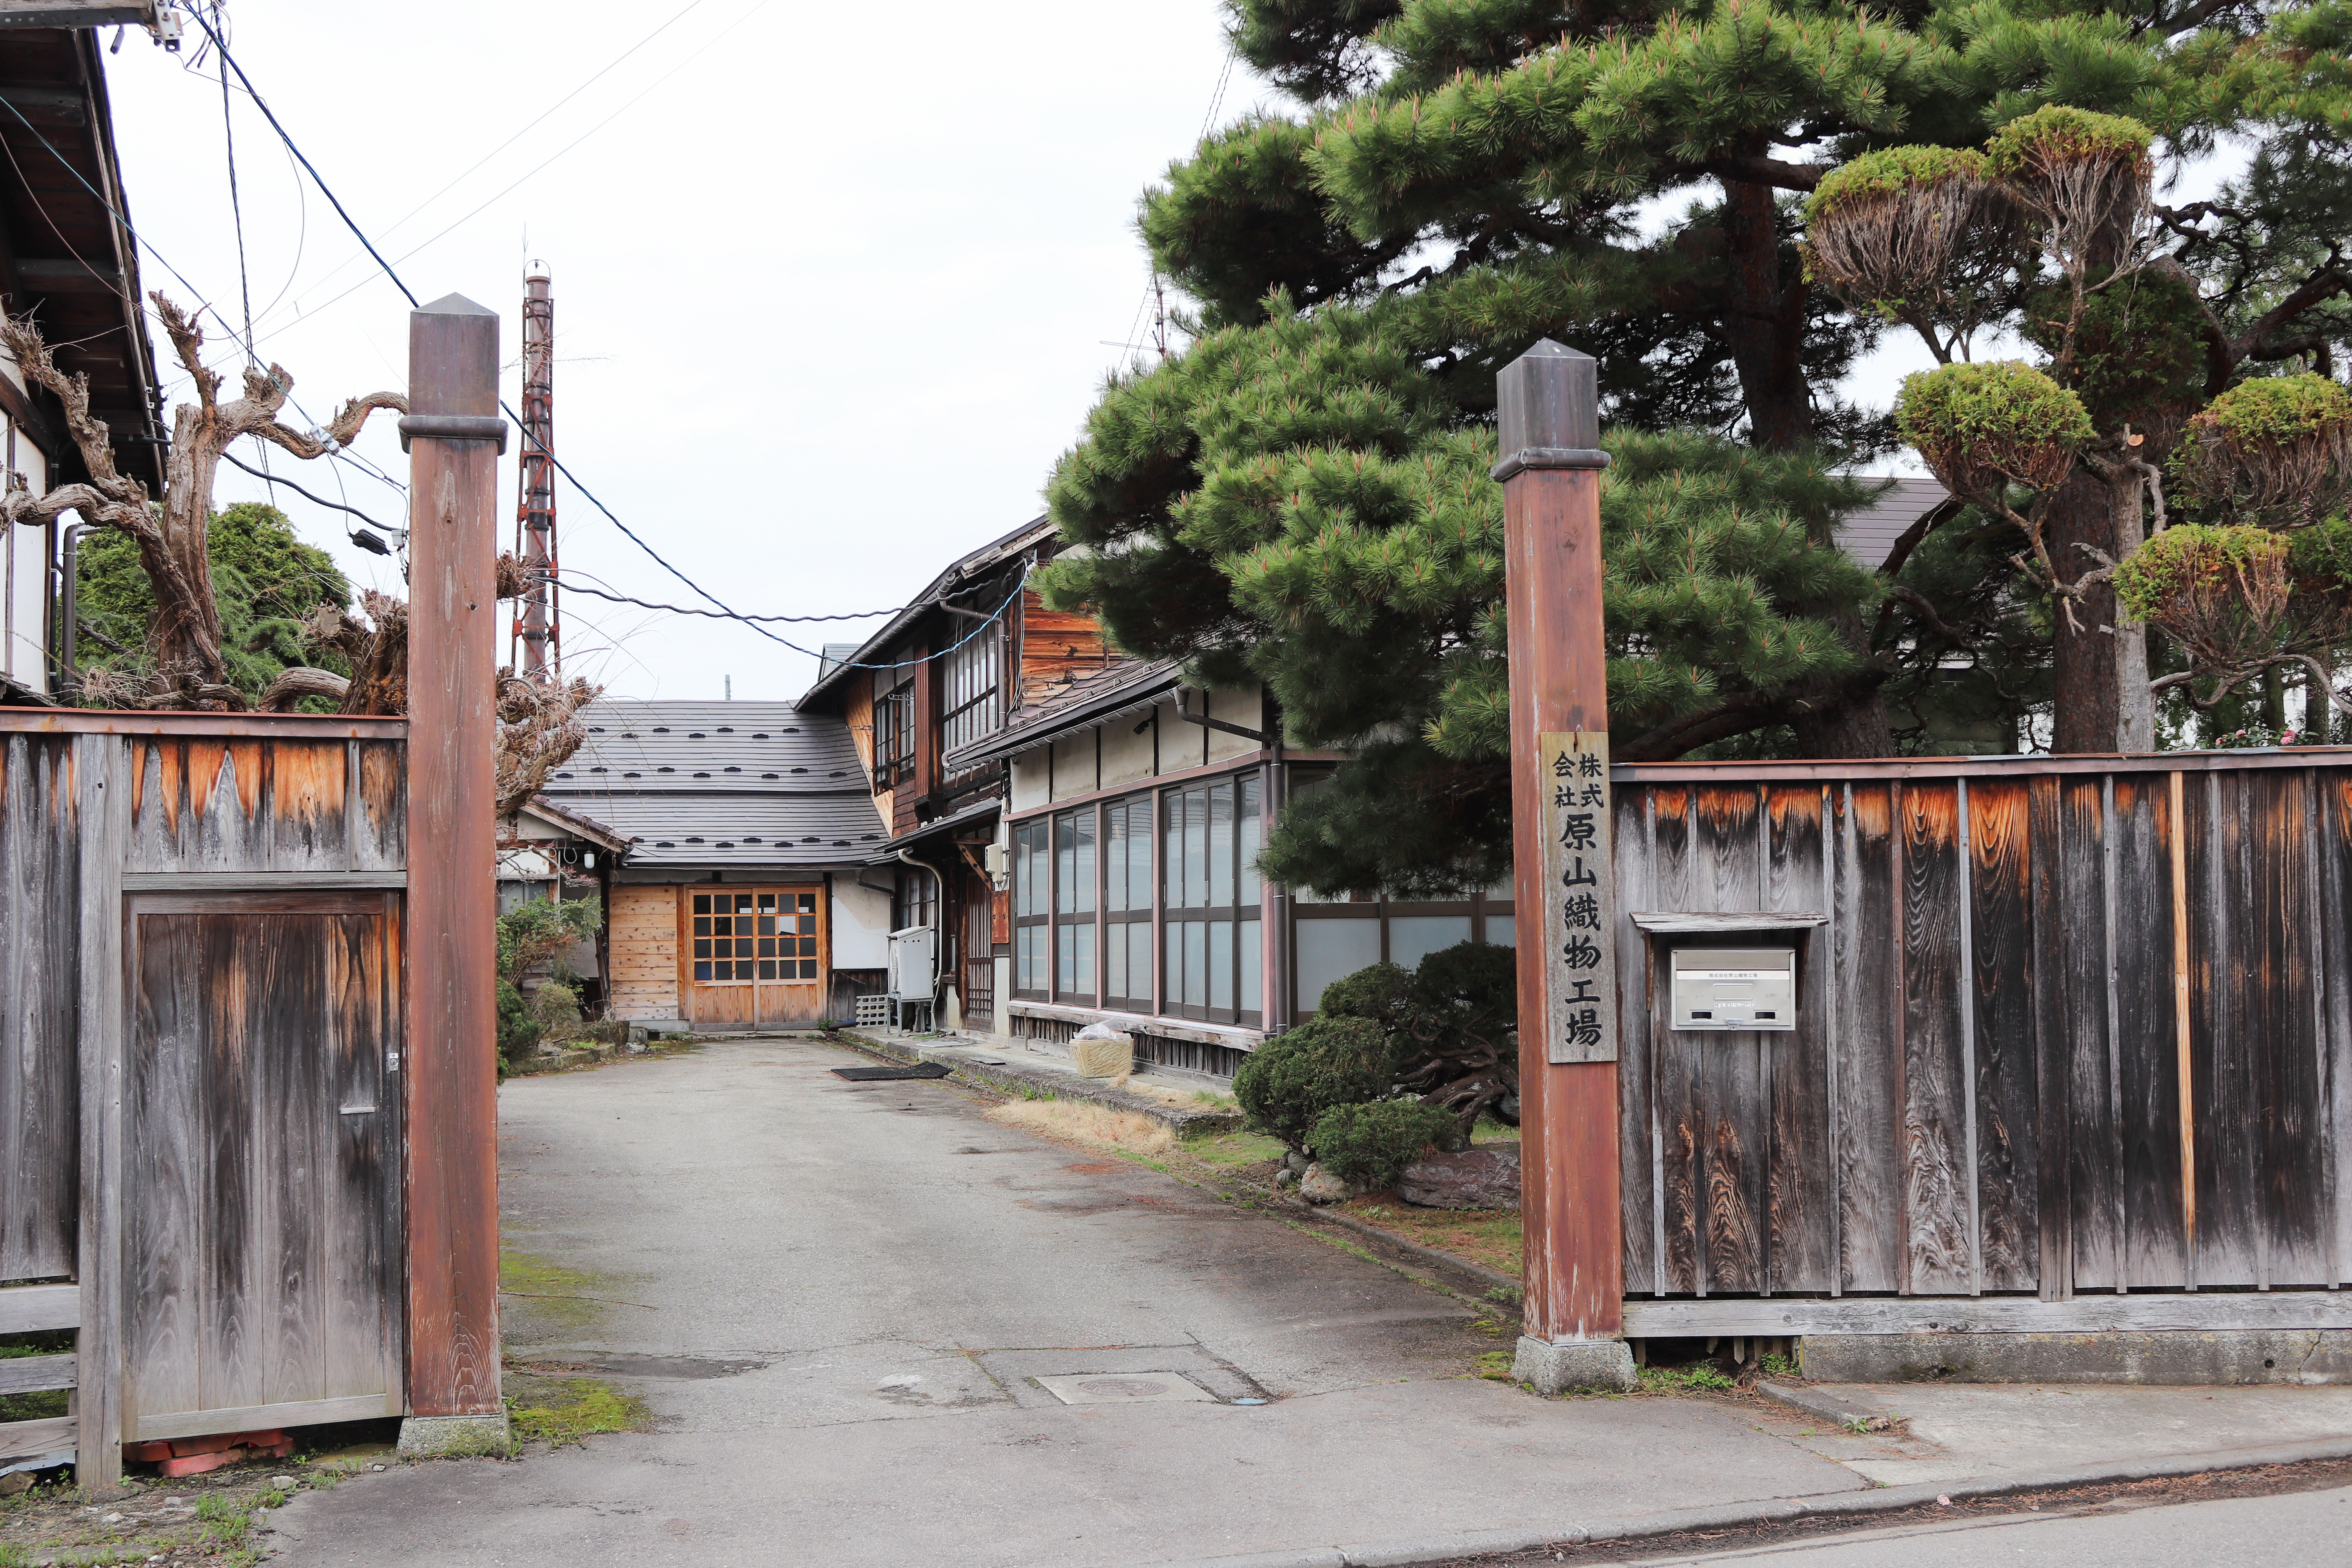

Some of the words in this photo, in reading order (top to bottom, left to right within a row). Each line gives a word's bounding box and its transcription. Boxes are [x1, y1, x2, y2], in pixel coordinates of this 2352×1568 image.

[1552, 750, 1577, 808] 会社
[1577, 753, 1604, 808] 株式
[1559, 813, 1602, 1046] 原山織物工場
